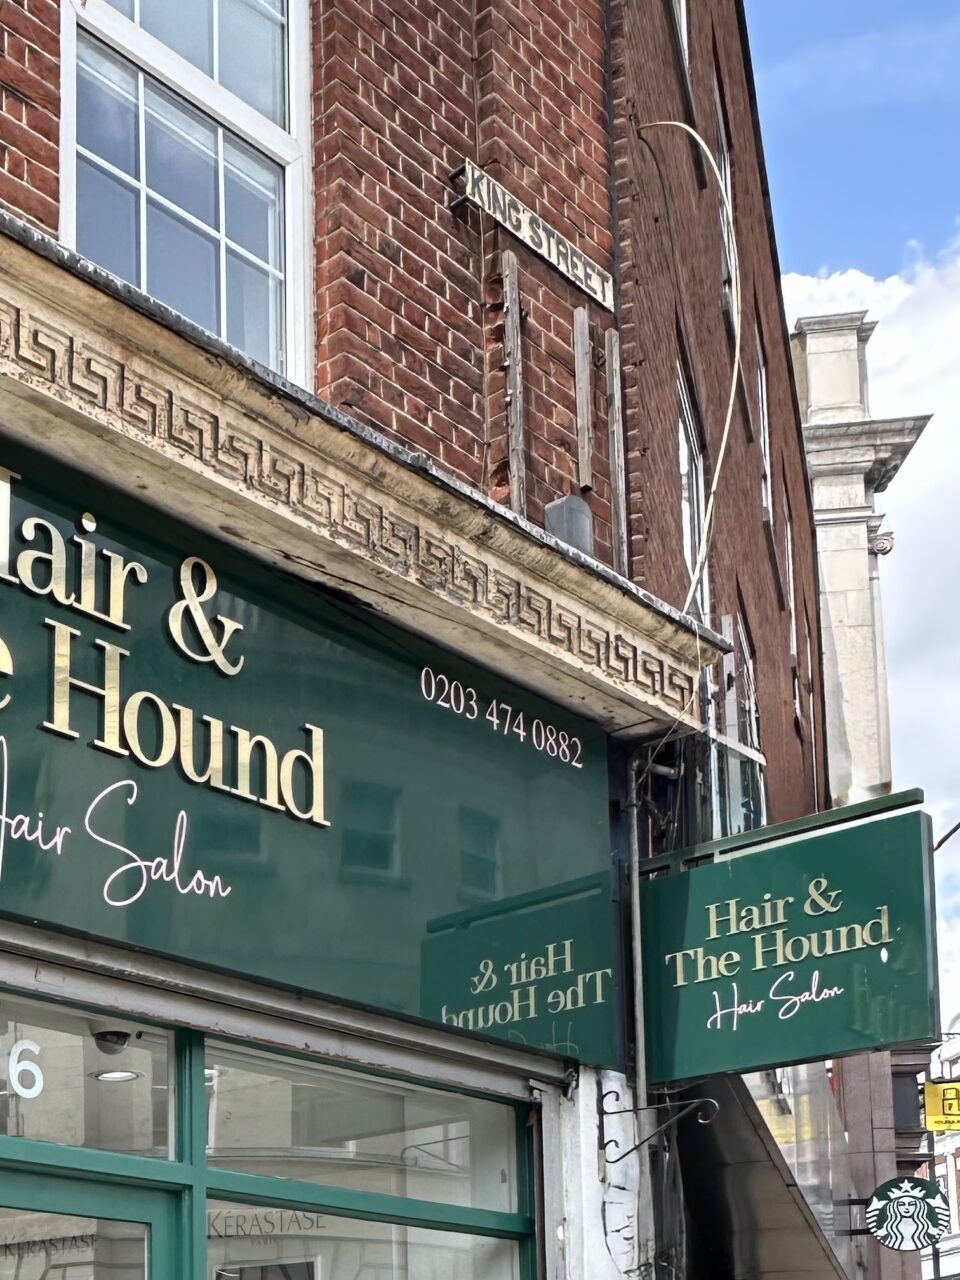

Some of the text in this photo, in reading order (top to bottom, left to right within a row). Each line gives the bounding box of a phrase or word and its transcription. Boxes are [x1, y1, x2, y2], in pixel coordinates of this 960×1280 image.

[469, 164, 611, 303] KING STREET
[168, 556, 244, 677] &
[41, 617, 331, 827] Hound
[420, 667, 584, 768] 0203 474 0882
[84, 780, 232, 907] Salon
[665, 905, 894, 987] The Hound
[705, 878, 844, 940] Hair &
[707, 970, 844, 1031] Hair Salon
[9, 1039, 43, 1098] 6
